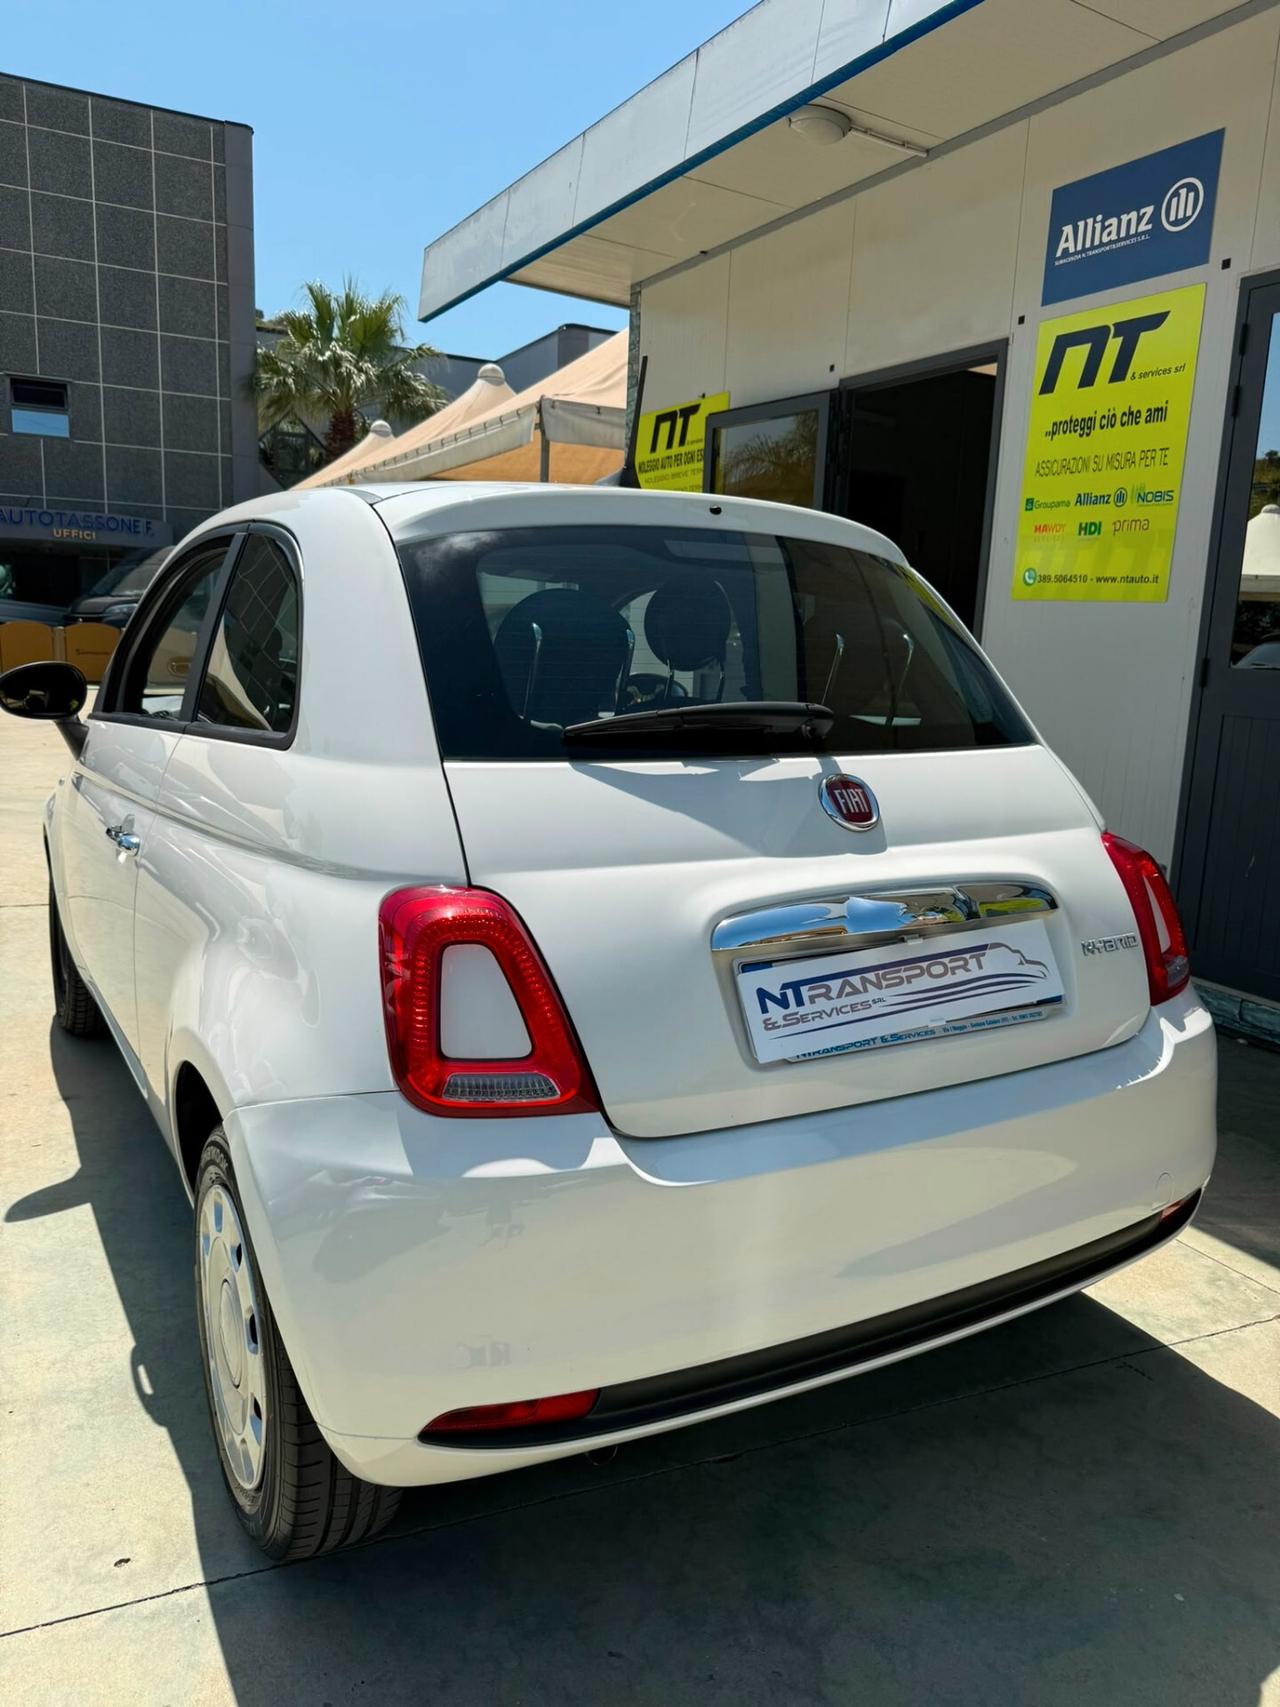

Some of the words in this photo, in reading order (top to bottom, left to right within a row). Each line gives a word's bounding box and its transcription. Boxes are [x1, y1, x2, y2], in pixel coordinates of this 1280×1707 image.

[1055, 205, 1155, 258] Allianz
[1130, 371, 1137, 381] &
[1138, 365, 1172, 380] services
[1173, 363, 1186, 373] srl
[1099, 408, 1116, 430] ciò
[1120, 405, 1141, 427] che
[1145, 400, 1169, 425] ami
[660, 455, 673, 470] AUTO
[673, 453, 683, 467] PER
[684, 450, 695, 465] OGNI
[1034, 455, 1091, 477] ASSICURAZIONI
[1092, 454, 1104, 472] SU
[1105, 451, 1136, 470] MISURA
[1139, 448, 1156, 468] PER
[1157, 447, 1170, 467] TE
[1034, 499, 1071, 511] Groupama
[1074, 492, 1112, 507] Allianz
[1136, 489, 1175, 504] NOBIS
[53, 527, 97, 541] UFFICI
[1077, 521, 1103, 537] HDI
[1112, 517, 1150, 536] prima
[1095, 573, 1160, 584] www.ntauto.it
[833, 788, 869, 814] FIAT
[1081, 932, 1139, 957] HYBRID
[755, 950, 987, 1014] NTRANSPORT
